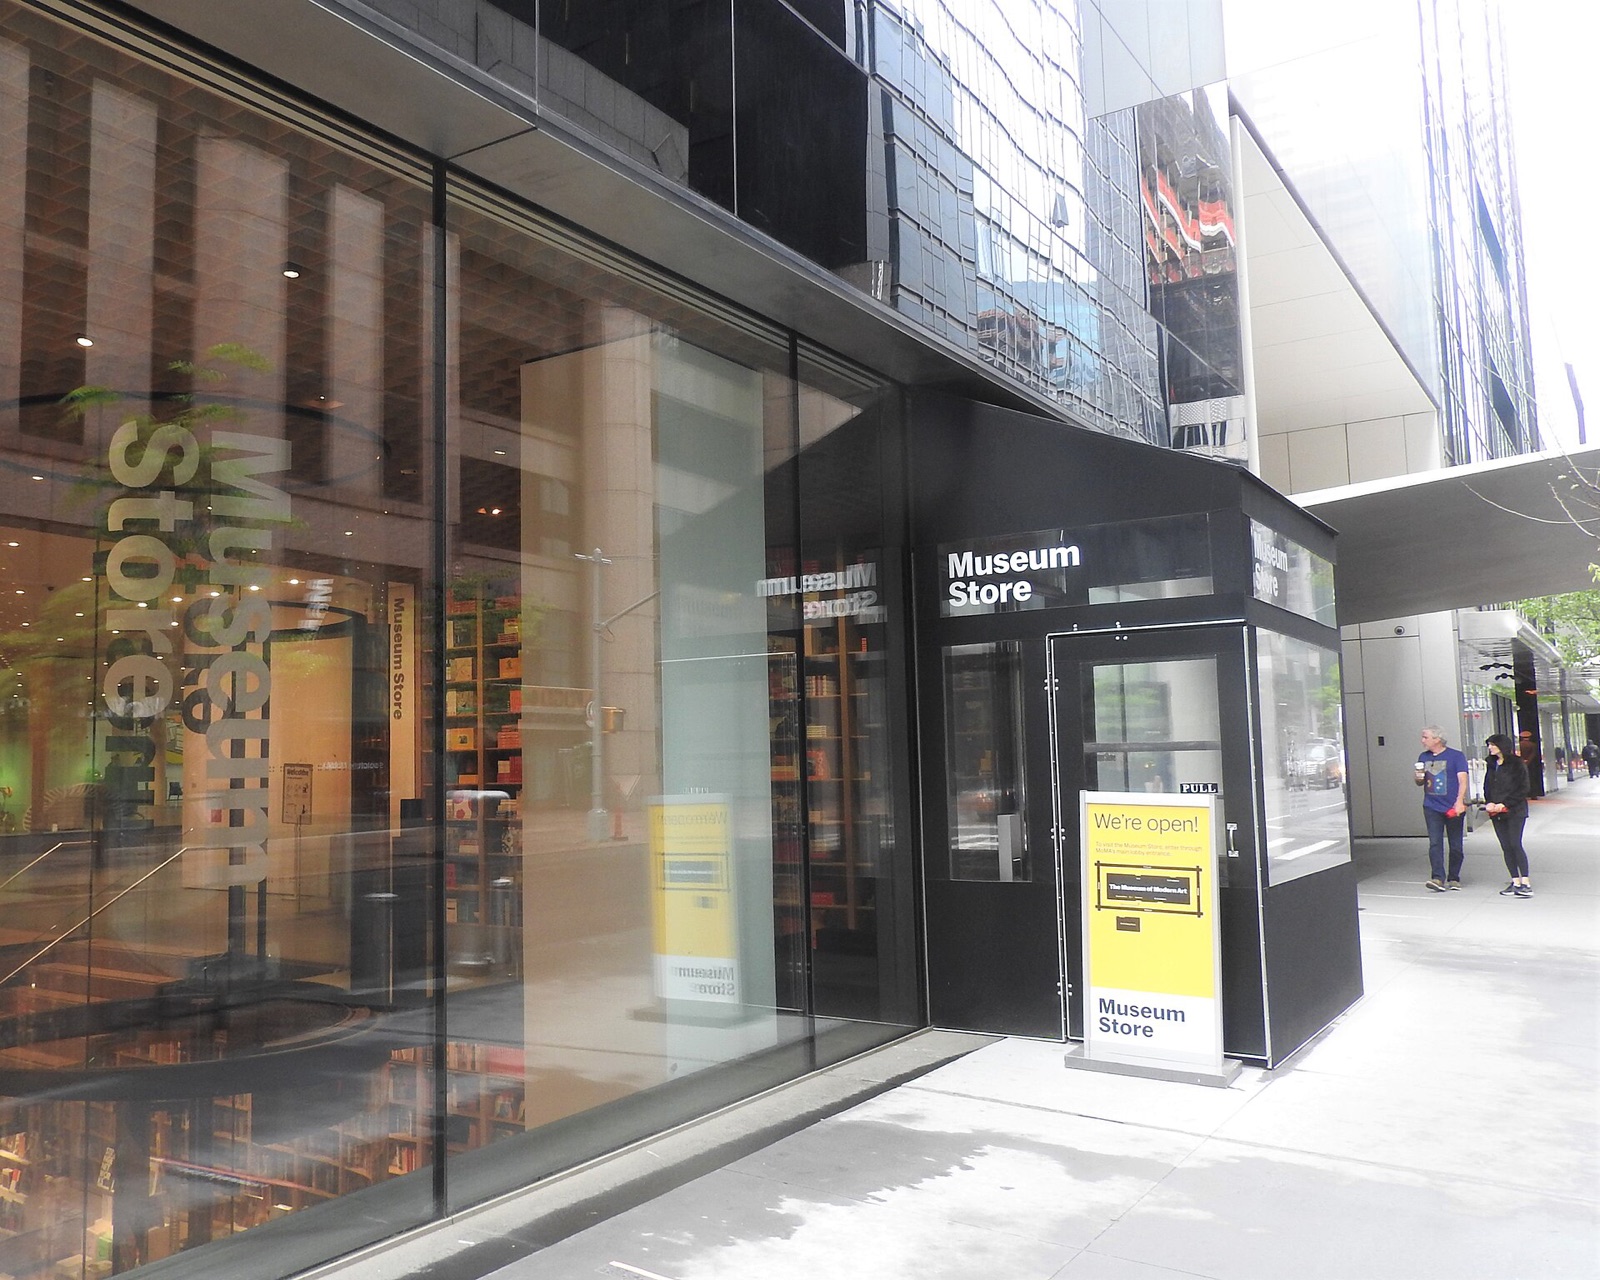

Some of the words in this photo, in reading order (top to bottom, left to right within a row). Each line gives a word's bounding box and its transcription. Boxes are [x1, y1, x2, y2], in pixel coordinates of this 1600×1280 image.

[948, 545, 1080, 578] Museum
[1254, 531, 1288, 572] Museum
[104, 420, 200, 719] Store
[1255, 562, 1279, 597] Store
[948, 580, 1032, 607] Store
[393, 597, 405, 669] Museum
[206, 430, 292, 886] Museum
[393, 672, 405, 720] Store
[1182, 784, 1217, 793] PULL
[1094, 813, 1142, 830] We're
[1147, 816, 1199, 834] open!
[1121, 884, 1146, 892] Museum
[1147, 885, 1153, 893] of
[1154, 886, 1177, 894] Modern
[1177, 887, 1188, 895] Art
[1099, 998, 1186, 1022] Museum
[1099, 1017, 1154, 1037] Store
